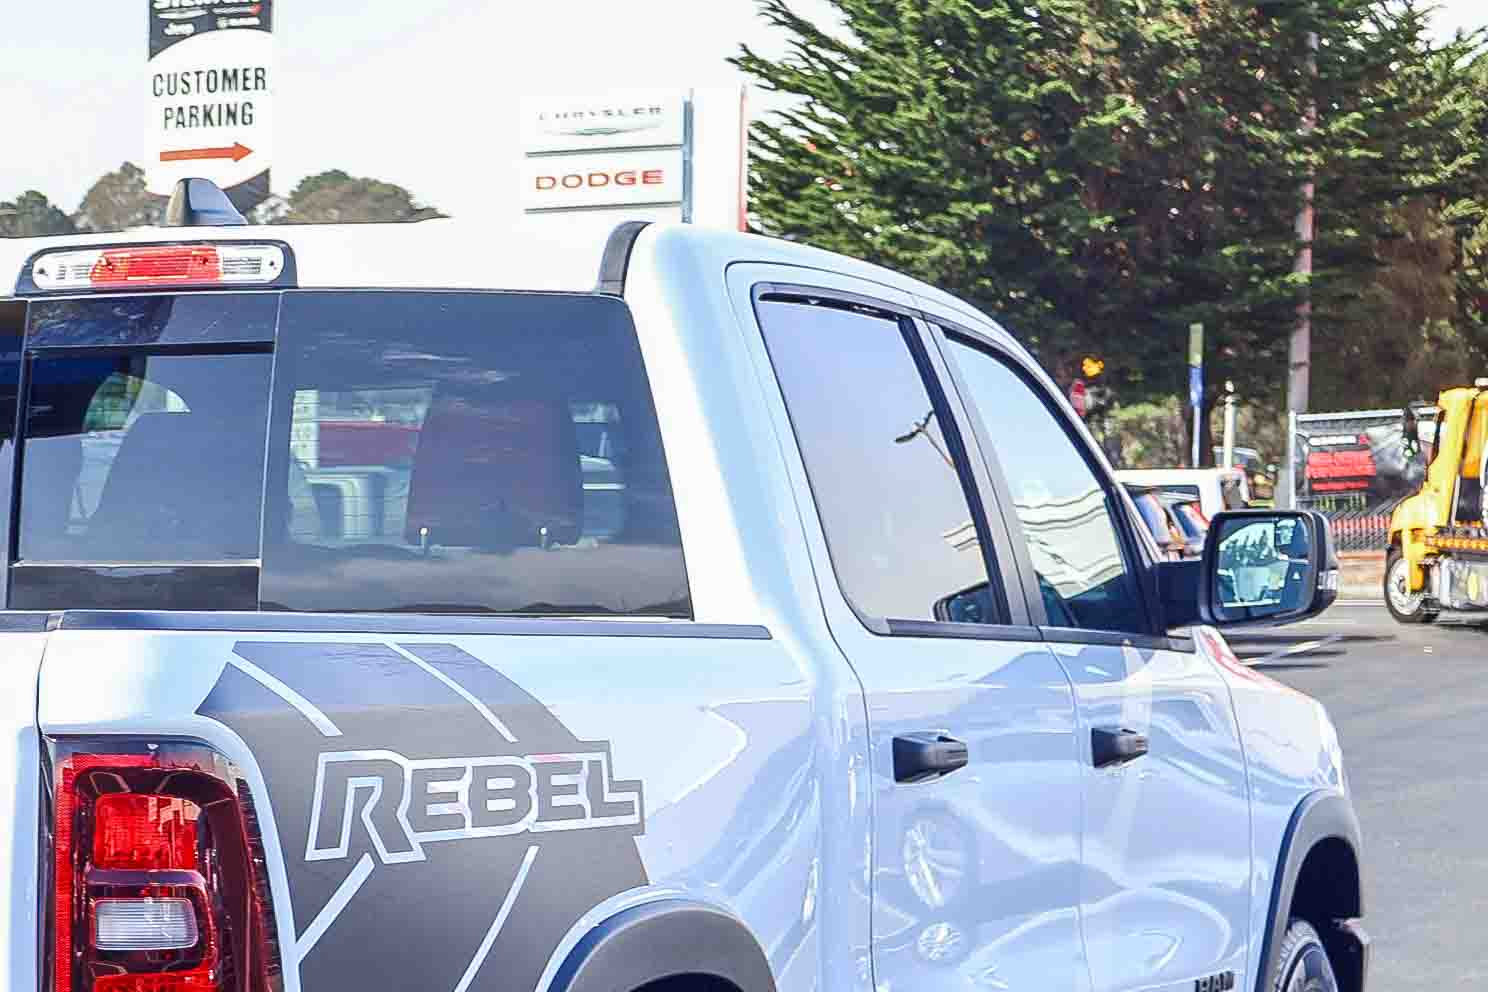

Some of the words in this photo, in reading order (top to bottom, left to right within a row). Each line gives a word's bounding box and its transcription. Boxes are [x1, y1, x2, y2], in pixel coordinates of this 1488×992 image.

[152, 67, 266, 97] CUSTOMER
[163, 102, 254, 129] PARKING
[535, 169, 664, 190] DODGE
[305, 749, 640, 864] REBEL
